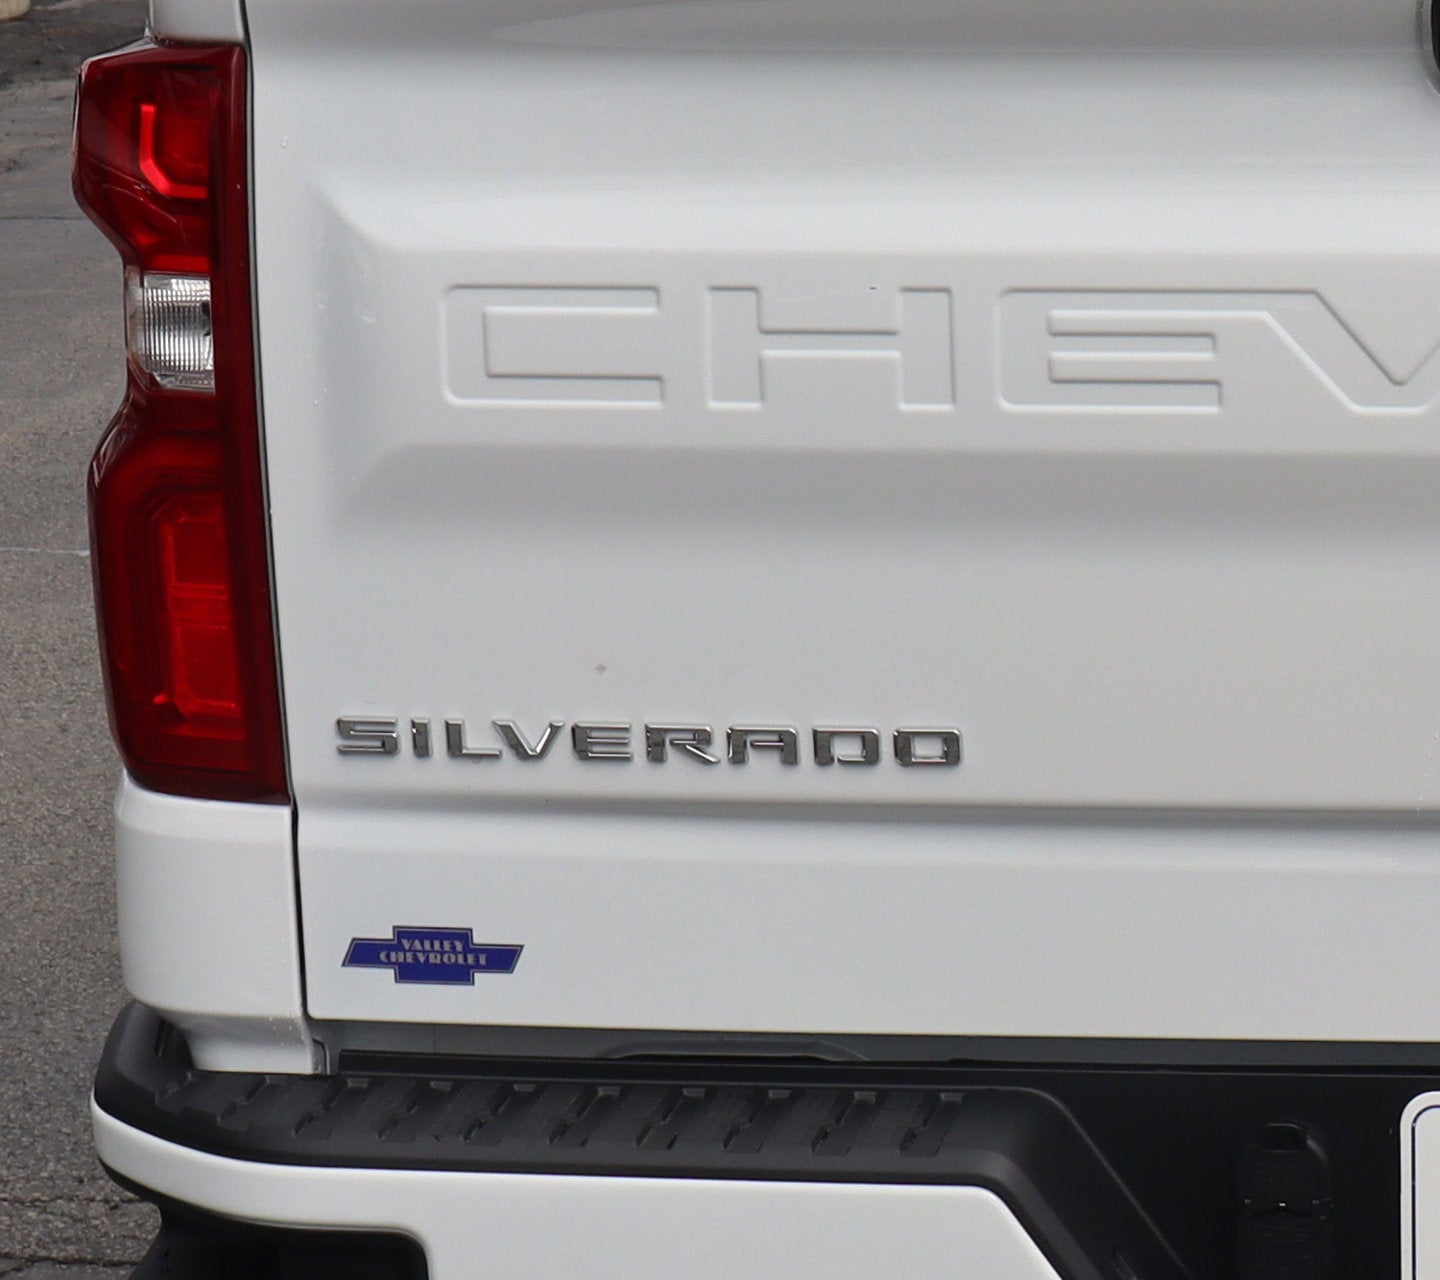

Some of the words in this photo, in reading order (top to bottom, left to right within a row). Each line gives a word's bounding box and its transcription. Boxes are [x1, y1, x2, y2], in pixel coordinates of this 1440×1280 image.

[335, 715, 963, 767] SILVERADO
[400, 938, 465, 952] VALLEY
[379, 950, 488, 966] CHEVROLET
